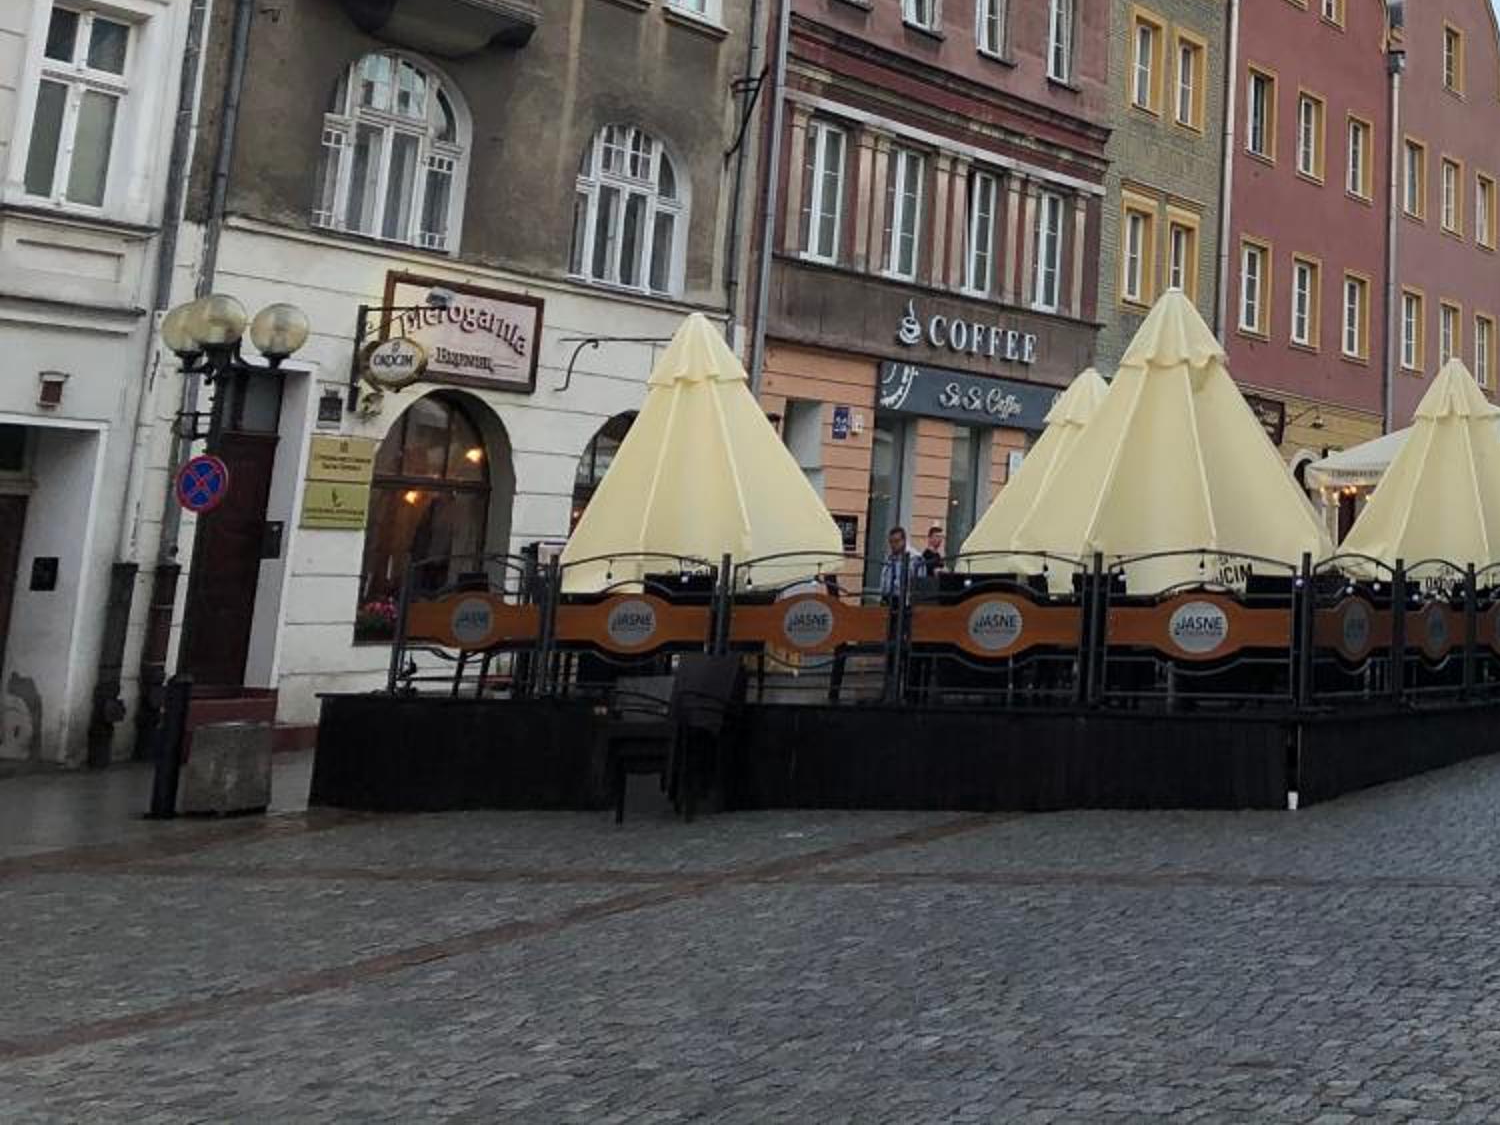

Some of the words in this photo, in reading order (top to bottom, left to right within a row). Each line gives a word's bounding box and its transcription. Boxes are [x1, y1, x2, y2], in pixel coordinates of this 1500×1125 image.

[929, 315, 1037, 363] COFFEE
[975, 613, 1017, 629] JASNE
[1176, 616, 1222, 631] JASNE
